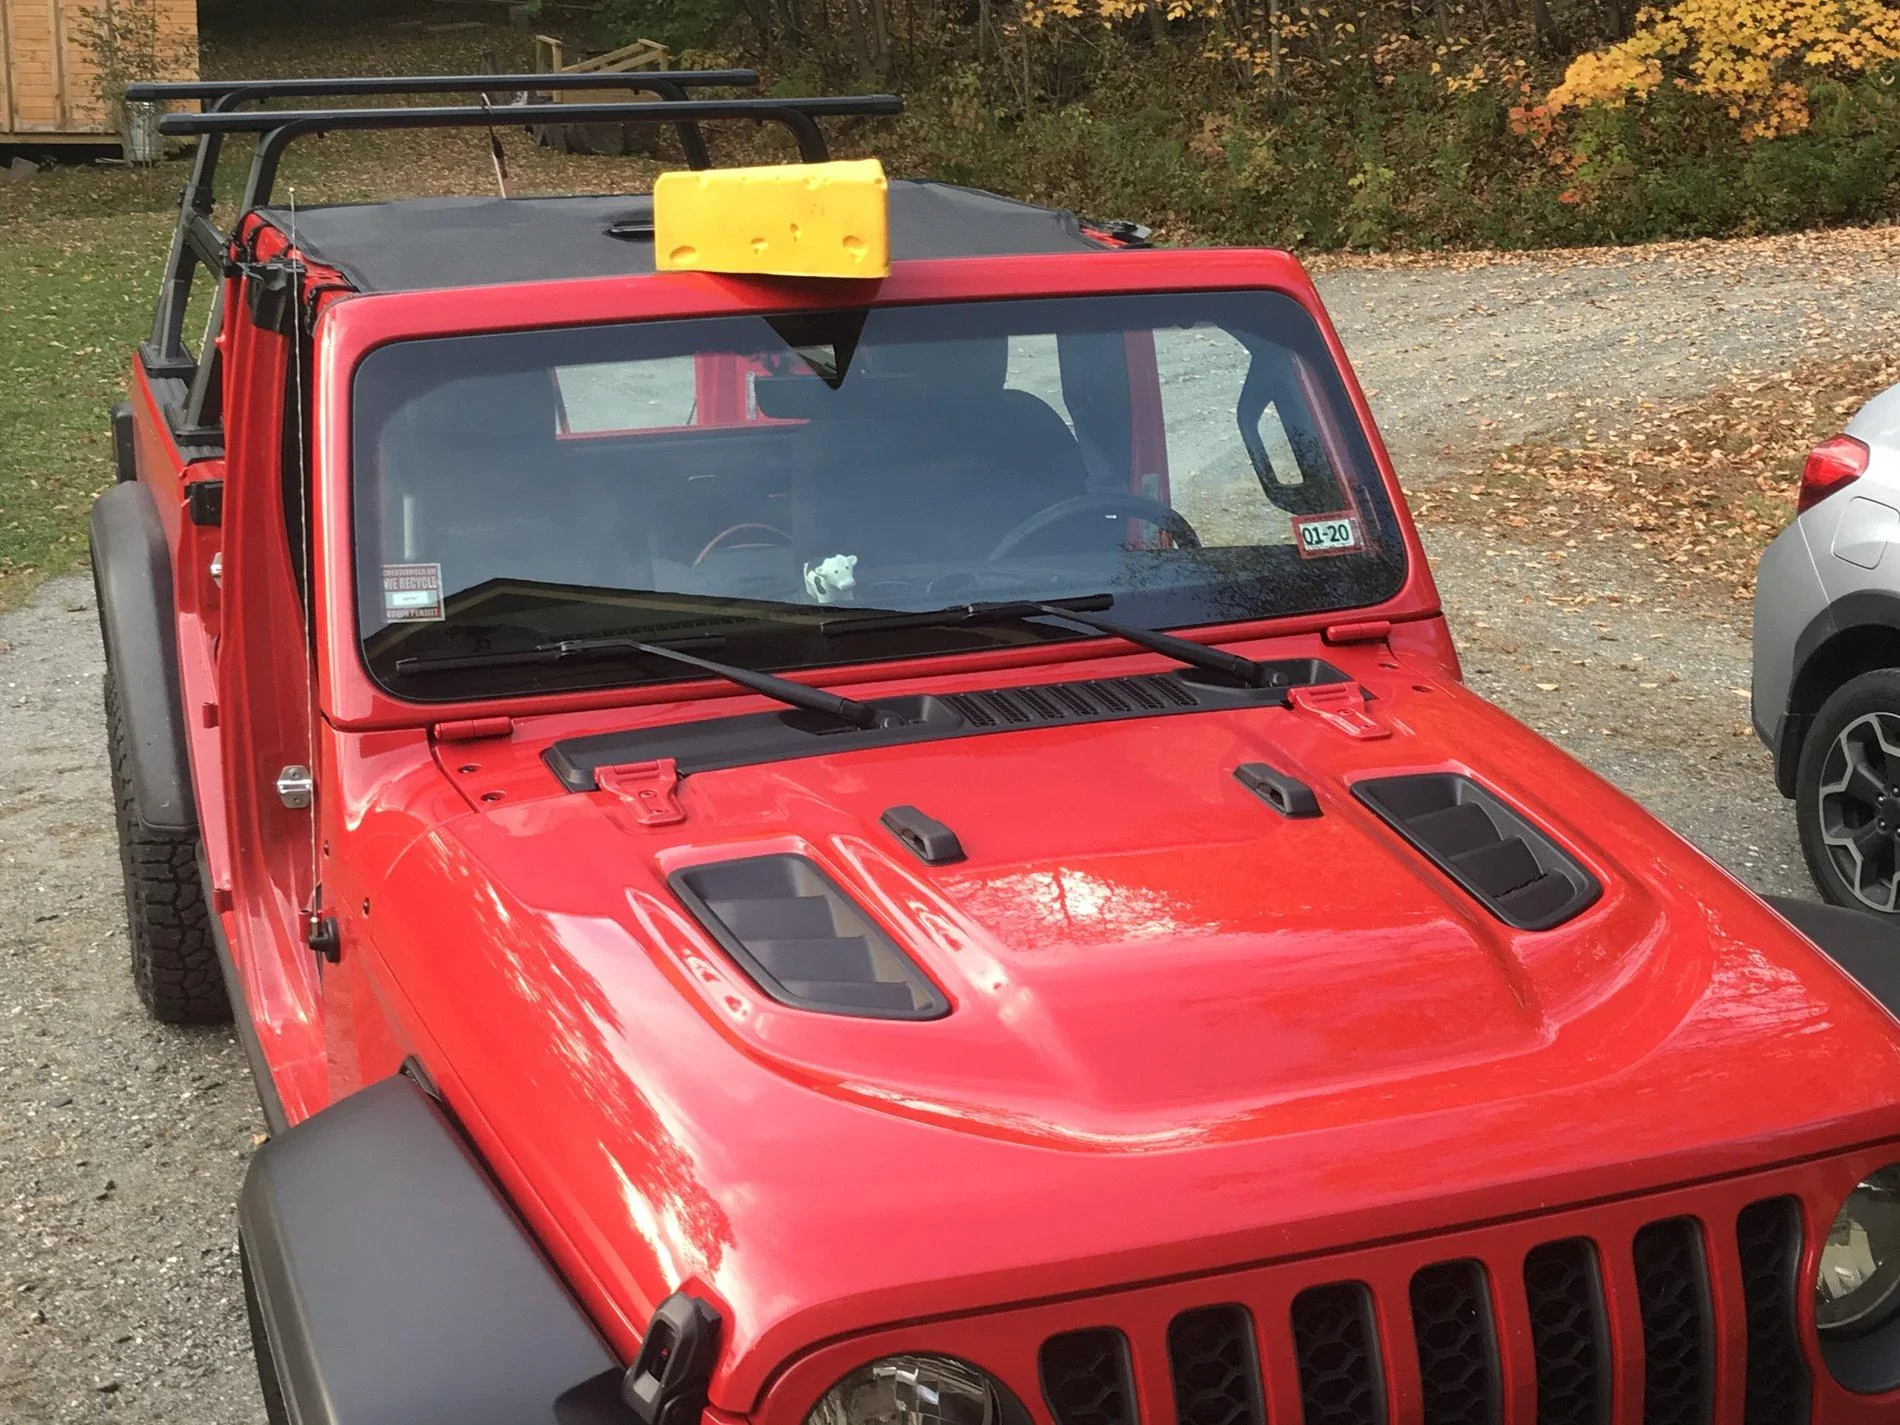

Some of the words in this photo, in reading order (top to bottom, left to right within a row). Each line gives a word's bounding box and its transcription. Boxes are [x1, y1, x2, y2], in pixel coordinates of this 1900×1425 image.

[1302, 523, 1350, 545] 01-20
[383, 577, 399, 590] WE
[399, 576, 438, 589] RECYCLE
